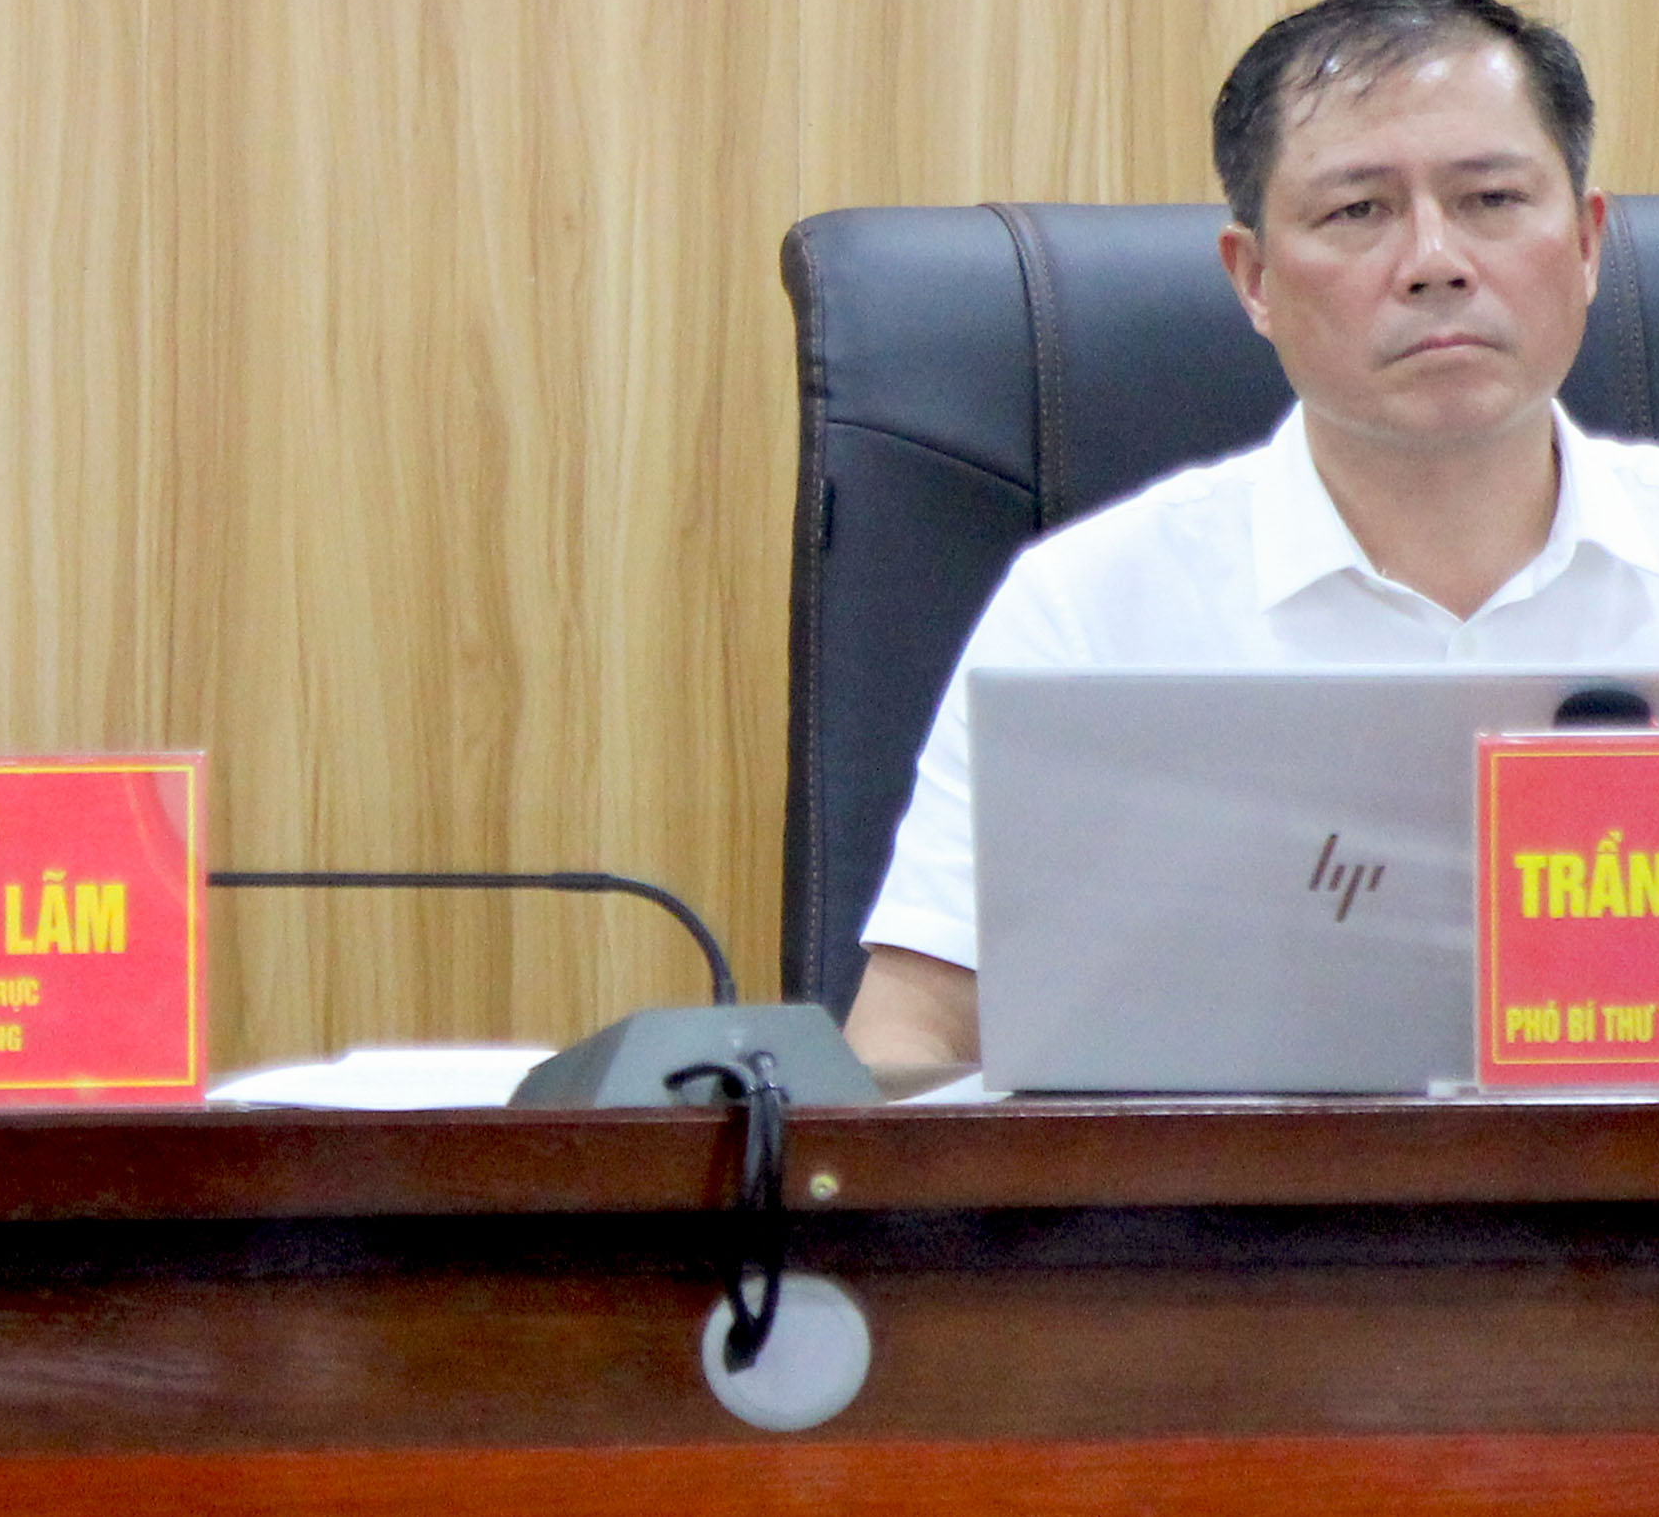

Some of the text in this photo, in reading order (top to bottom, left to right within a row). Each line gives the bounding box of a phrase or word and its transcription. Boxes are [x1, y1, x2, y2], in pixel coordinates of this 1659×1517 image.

[4, 869, 127, 954] LÃM
[1308, 833, 1386, 923] hp
[1505, 1000, 1561, 1043] PHÓ
